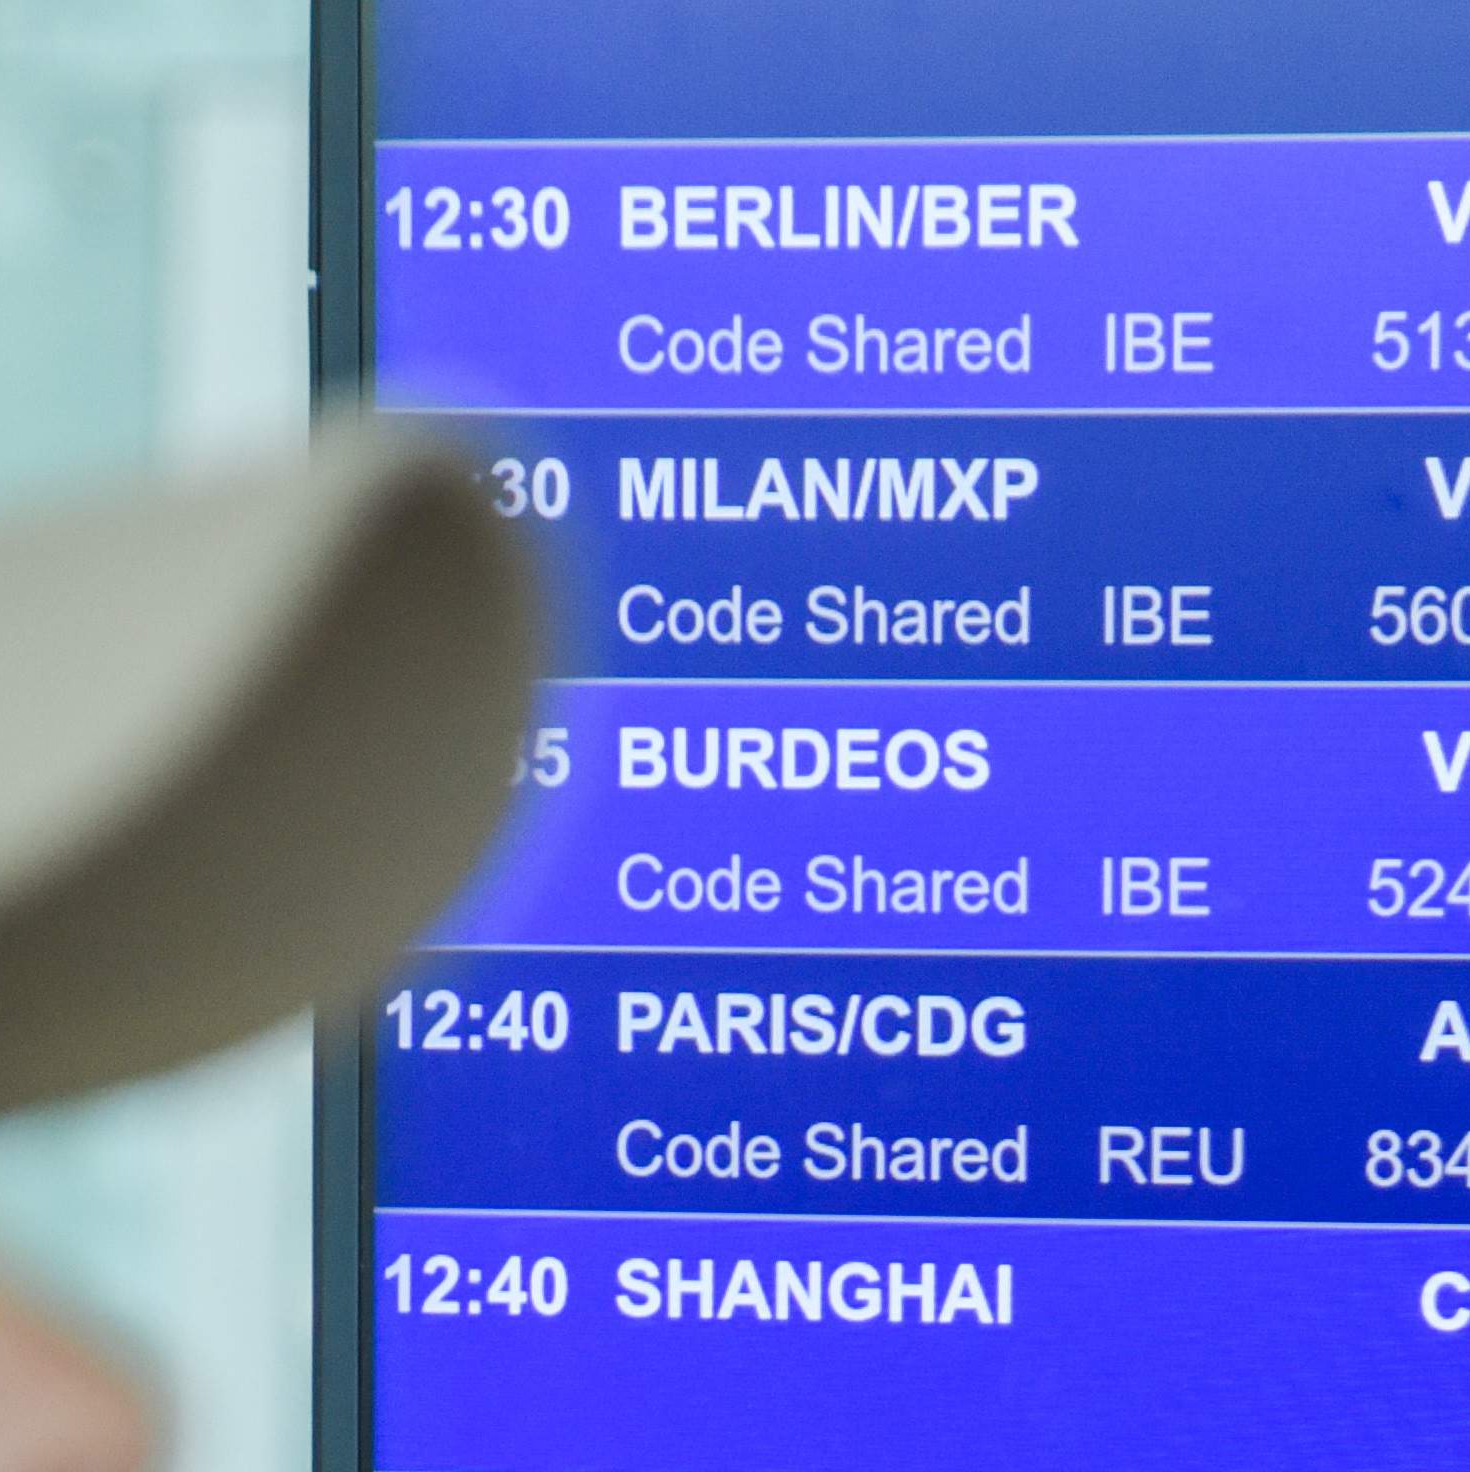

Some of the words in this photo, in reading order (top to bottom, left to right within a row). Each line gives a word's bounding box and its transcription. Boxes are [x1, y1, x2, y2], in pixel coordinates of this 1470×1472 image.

[384, 184, 572, 252] 12:30
[618, 182, 1082, 252] BERLIN/BER
[617, 311, 785, 376] Code
[804, 311, 1033, 376] Shared
[1103, 311, 1216, 375] IBE
[618, 456, 1040, 522] MILAN/MXP
[617, 583, 784, 645] Code
[805, 584, 1031, 646] Shared
[1103, 584, 1213, 646] IBE
[617, 725, 992, 793] BURDEOS
[616, 851, 783, 914] Code
[803, 853, 1029, 916] Shared
[1101, 855, 1212, 918] IBE
[385, 988, 570, 1053] 12:40
[617, 990, 1026, 1058] PARIS/CDG
[616, 1118, 782, 1180] Code
[803, 1121, 1028, 1184] Shared
[1099, 1125, 1244, 1186] REU
[383, 1252, 570, 1318] 12:40
[614, 1256, 1014, 1326] SHANGHAI
